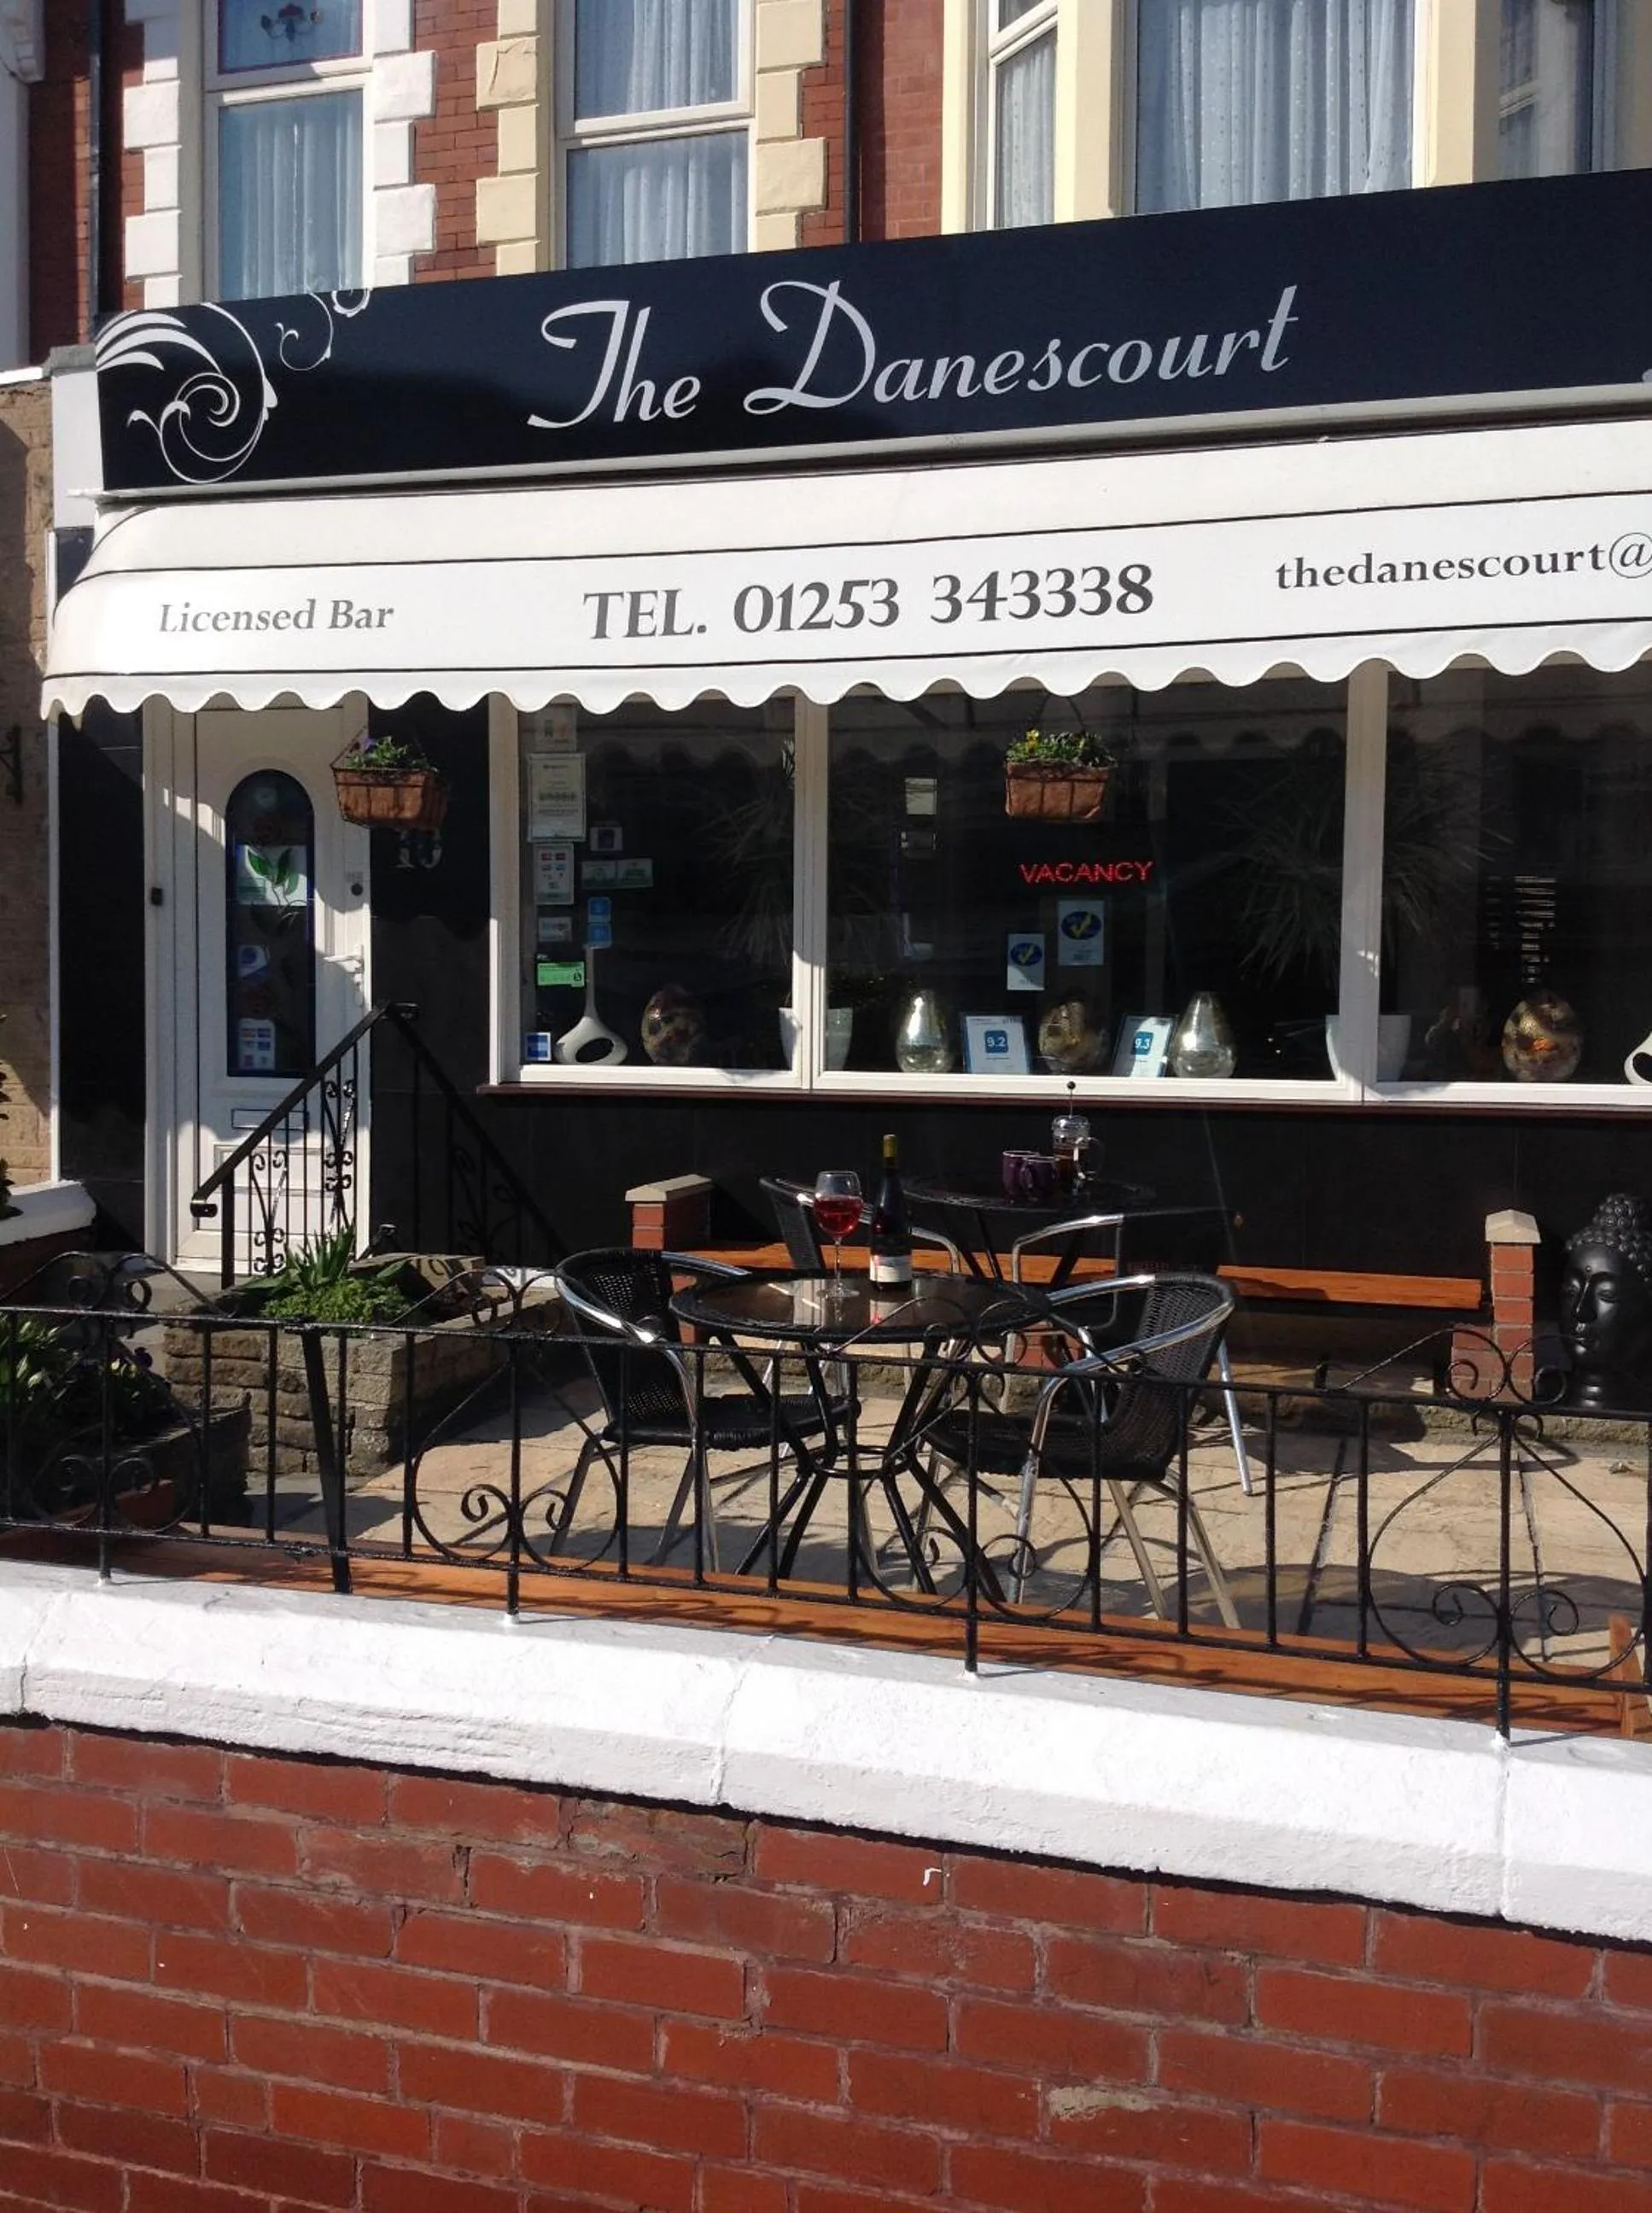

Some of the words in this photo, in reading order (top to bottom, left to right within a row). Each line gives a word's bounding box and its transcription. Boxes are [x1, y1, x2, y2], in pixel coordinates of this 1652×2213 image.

[527, 300, 701, 429] The
[743, 279, 1299, 416] Danescourt
[1277, 532, 1652, 589] thedanescourt@
[159, 598, 317, 633] Licensed
[327, 599, 395, 630] Bar
[583, 588, 708, 639] TEL.
[733, 578, 900, 633] 01253
[930, 563, 1153, 624] 343338
[1019, 861, 1153, 883] VACANCY
[986, 1036, 1006, 1048] 9.2
